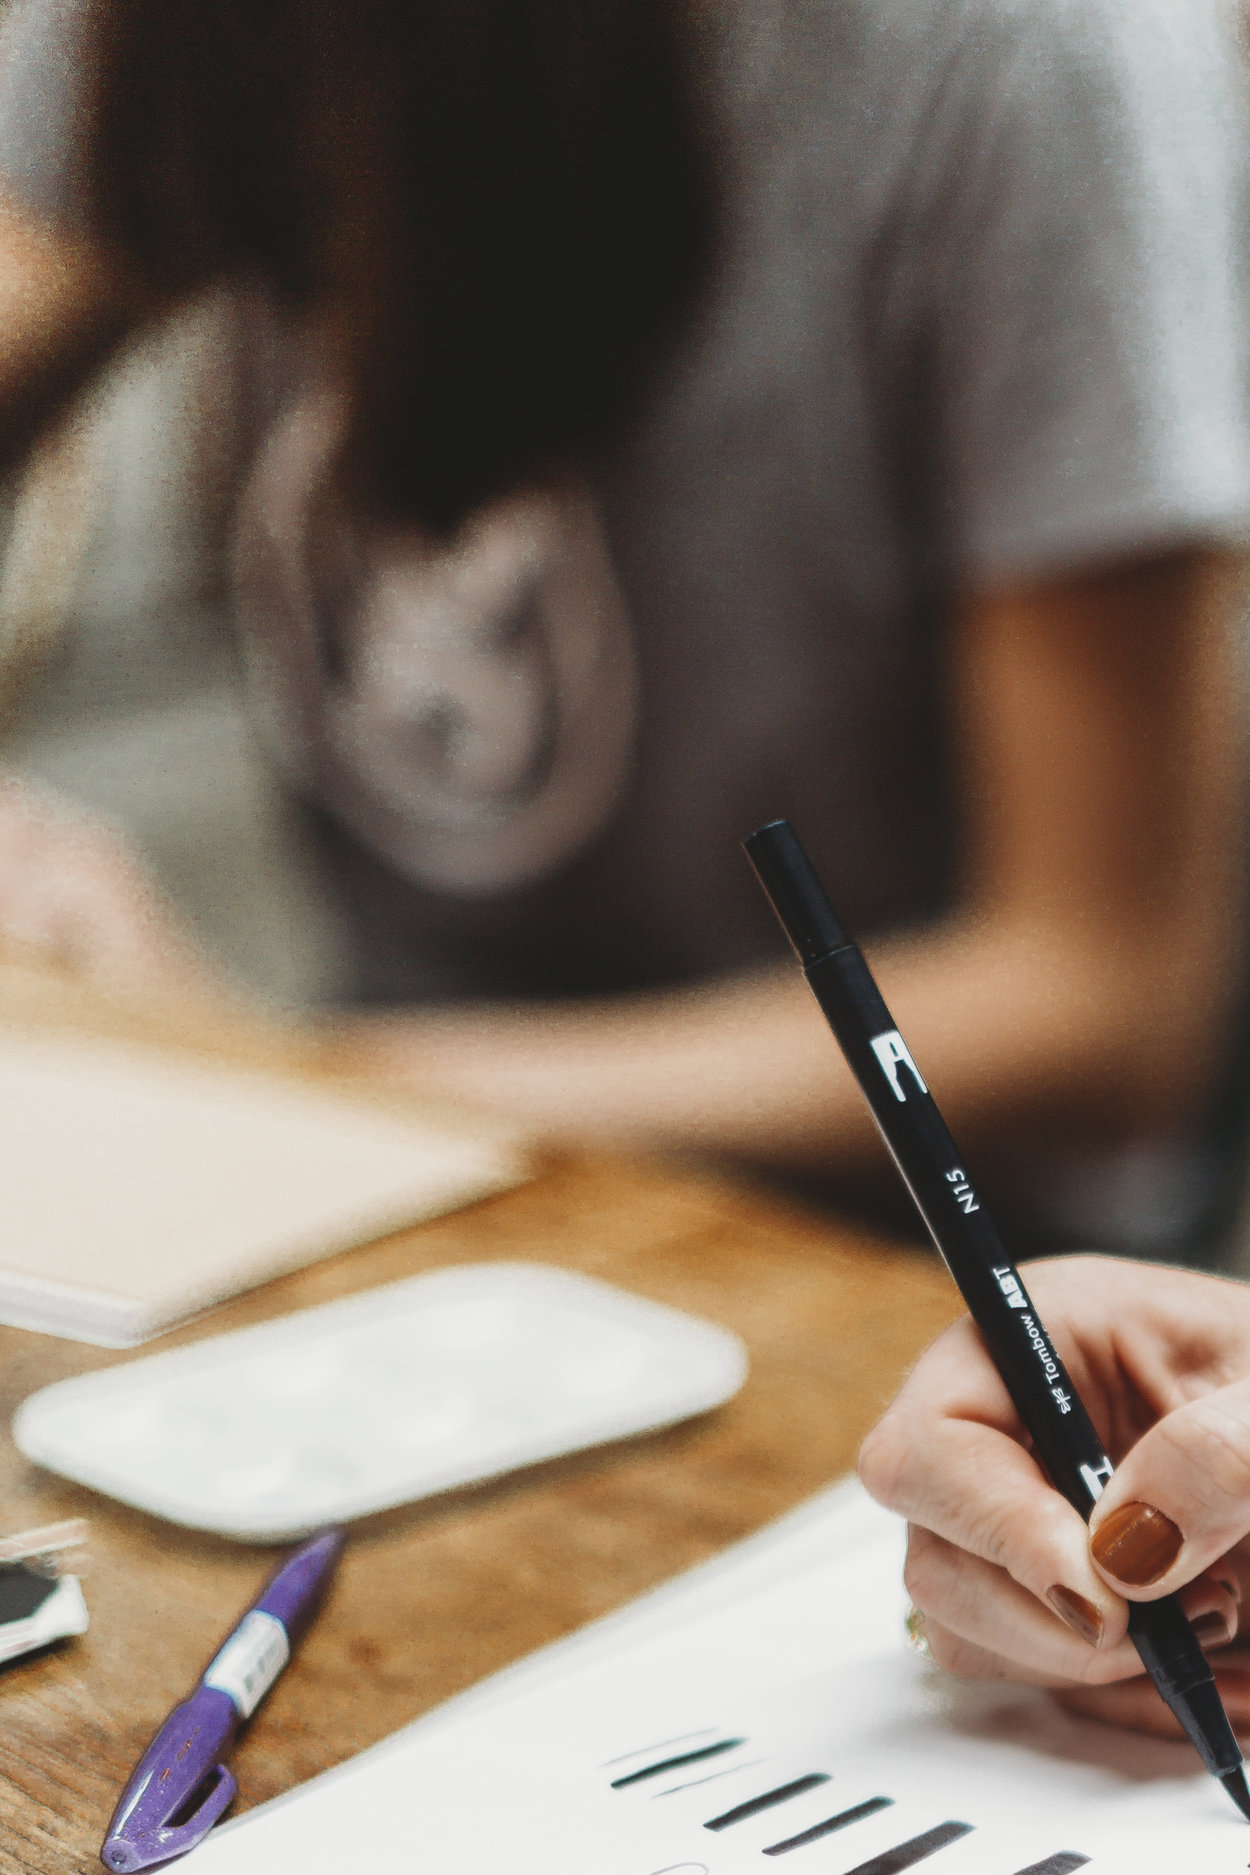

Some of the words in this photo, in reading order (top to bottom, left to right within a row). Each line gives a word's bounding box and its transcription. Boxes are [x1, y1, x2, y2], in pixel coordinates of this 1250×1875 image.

[945, 1167, 980, 1214] N15
[992, 1265, 1028, 1309] ABT
[1020, 1313, 1061, 1385] Tombow
